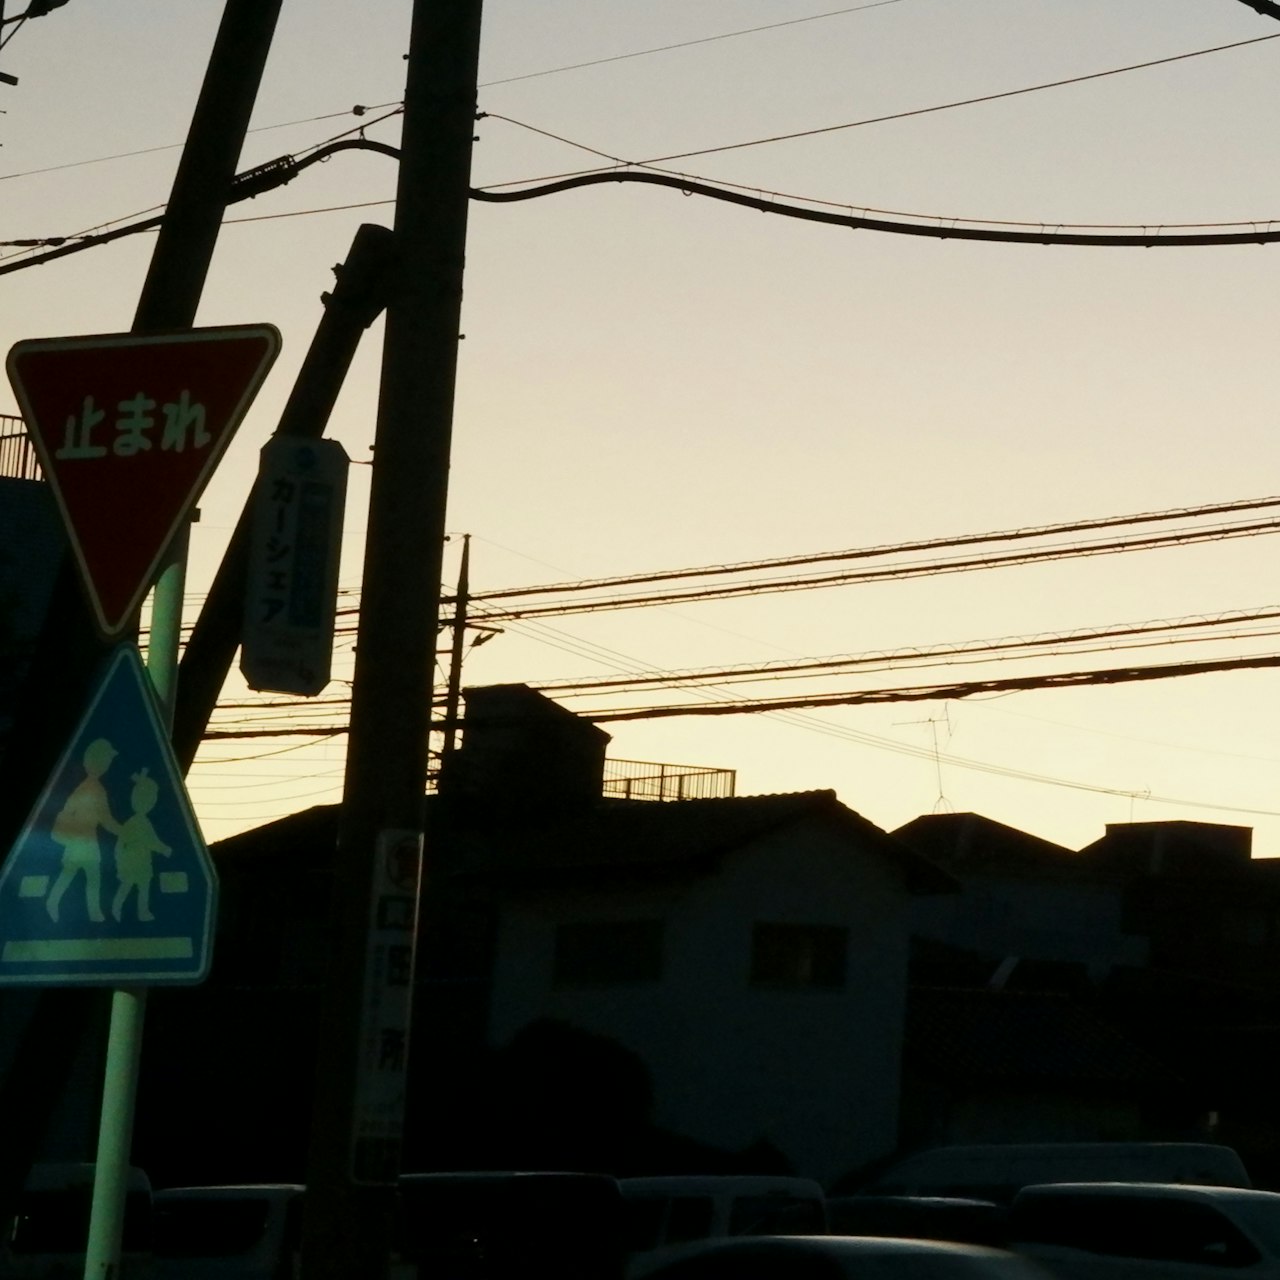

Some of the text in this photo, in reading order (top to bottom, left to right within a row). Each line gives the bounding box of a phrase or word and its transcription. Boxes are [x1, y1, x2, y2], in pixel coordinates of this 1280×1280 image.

[55, 387, 212, 462] 止まれ
[260, 477, 297, 624] カーシェア
